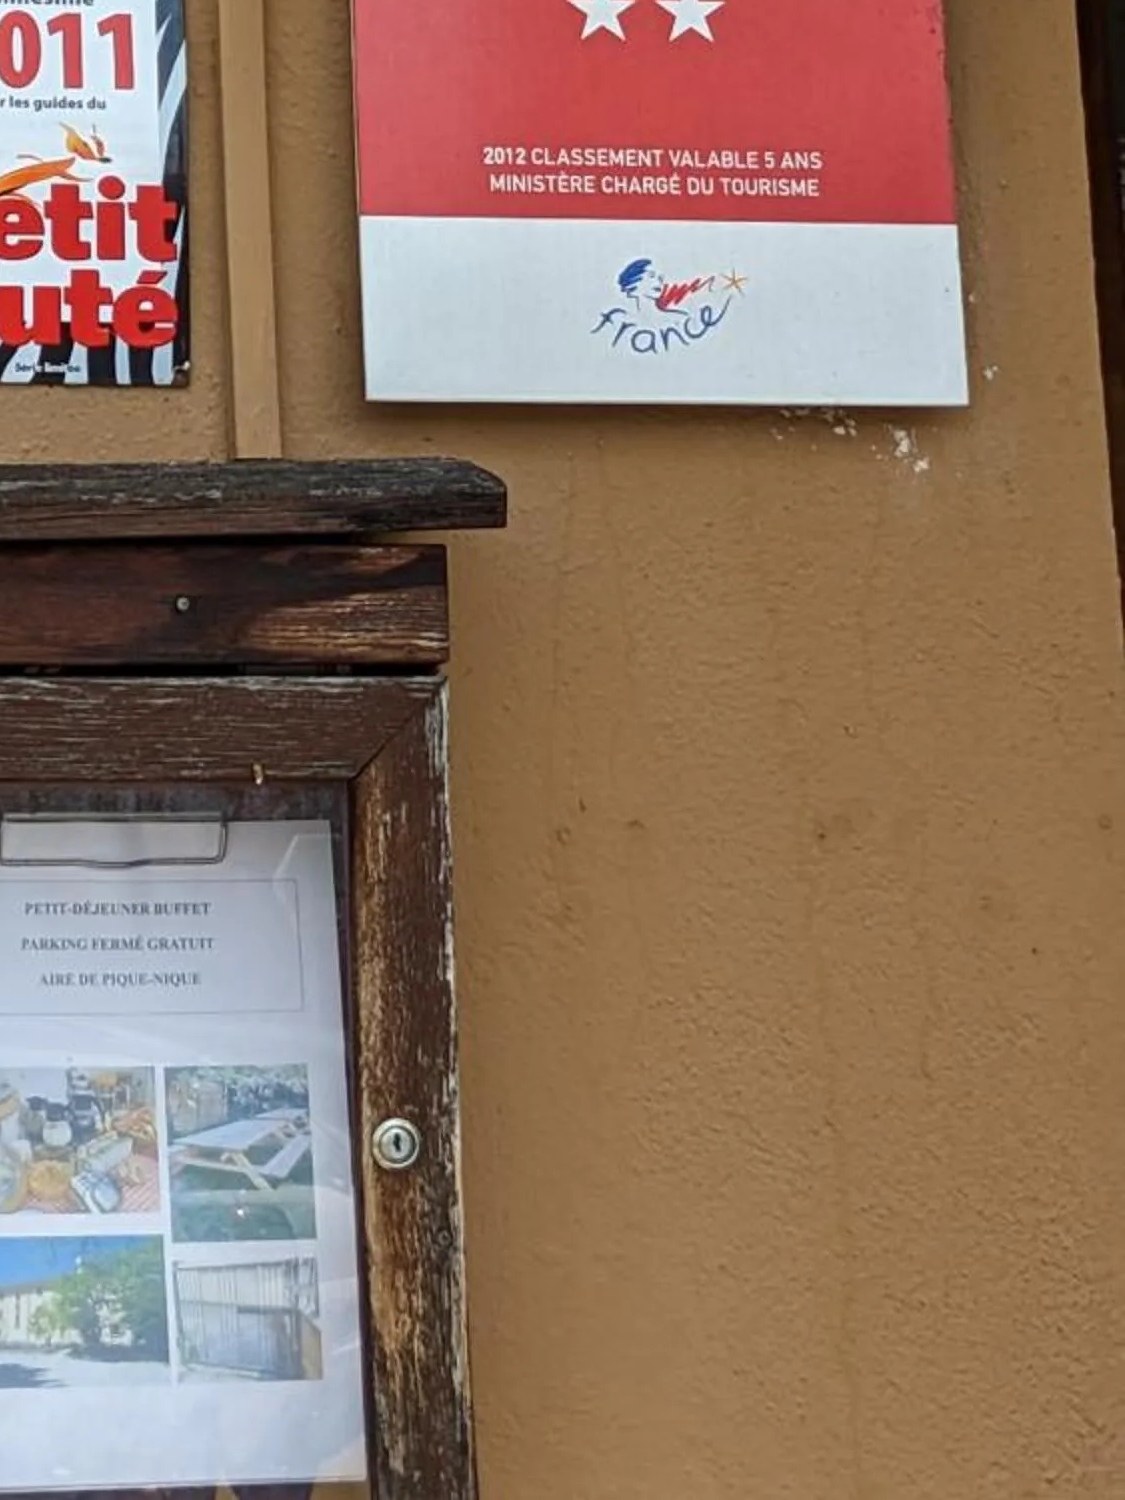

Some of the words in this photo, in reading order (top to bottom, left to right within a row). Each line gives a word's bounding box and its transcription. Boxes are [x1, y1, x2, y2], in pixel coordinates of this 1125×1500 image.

[9, 96, 29, 108] les
[33, 97, 83, 111] guides
[87, 97, 106, 109] du
[483, 147, 525, 164] 2012
[531, 148, 662, 167] CLASSEMENT
[669, 150, 758, 168] VALABLE
[764, 152, 774, 168] 5
[780, 152, 822, 169] ANS
[490, 171, 595, 193] MINISTÈRE
[602, 174, 680, 194] CHARGÉ
[688, 178, 714, 194] DU
[721, 178, 819, 197] TOURISME
[24, 901, 150, 917] PETIT-DÉJEUNER
[154, 901, 212, 916] BUFFET
[21, 937, 88, 950] PARKING
[92, 934, 143, 950] FERMÉ
[147, 937, 214, 950] GRATUIT
[41, 972, 74, 986] AIRE
[79, 973, 98, 985] DE
[102, 972, 201, 987] PIQUE-NIQUE
